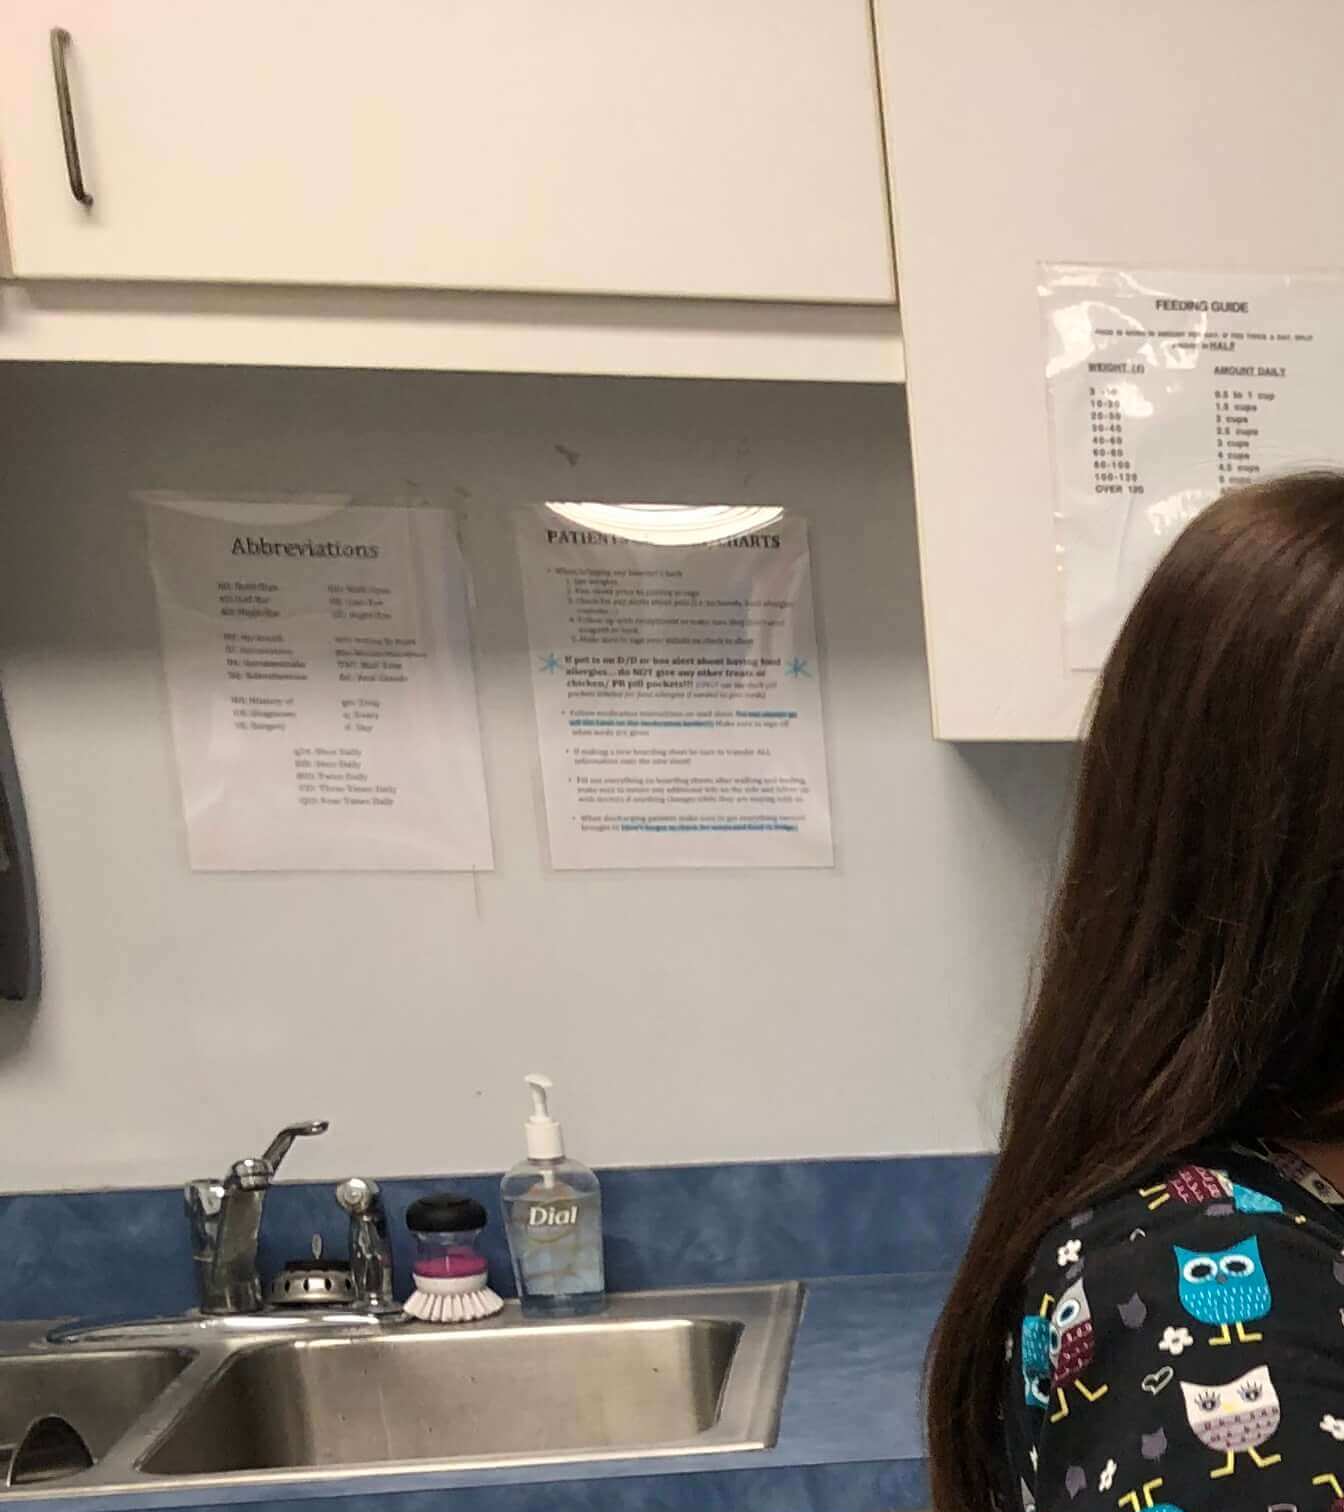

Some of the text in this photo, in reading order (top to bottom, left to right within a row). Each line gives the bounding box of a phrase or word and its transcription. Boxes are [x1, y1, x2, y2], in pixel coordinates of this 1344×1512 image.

[1155, 299, 1250, 314] FEEDING GUIDE
[1088, 362, 1127, 375] WEIGHT
[1213, 366, 1287, 378] AMOUNT DAILY
[1257, 392, 1276, 401] cup
[1234, 404, 1258, 413] cups
[1225, 416, 1249, 425] cups
[1226, 440, 1250, 449] cups
[1227, 452, 1251, 461] cups
[1095, 484, 1123, 494] OVER
[231, 536, 380, 559] Abbreviations
[574, 656, 589, 667] pet
[697, 656, 724, 667] about
[632, 668, 653, 678] NOT
[656, 669, 675, 680] give
[697, 668, 724, 678] other
[529, 1205, 579, 1227] Dial
